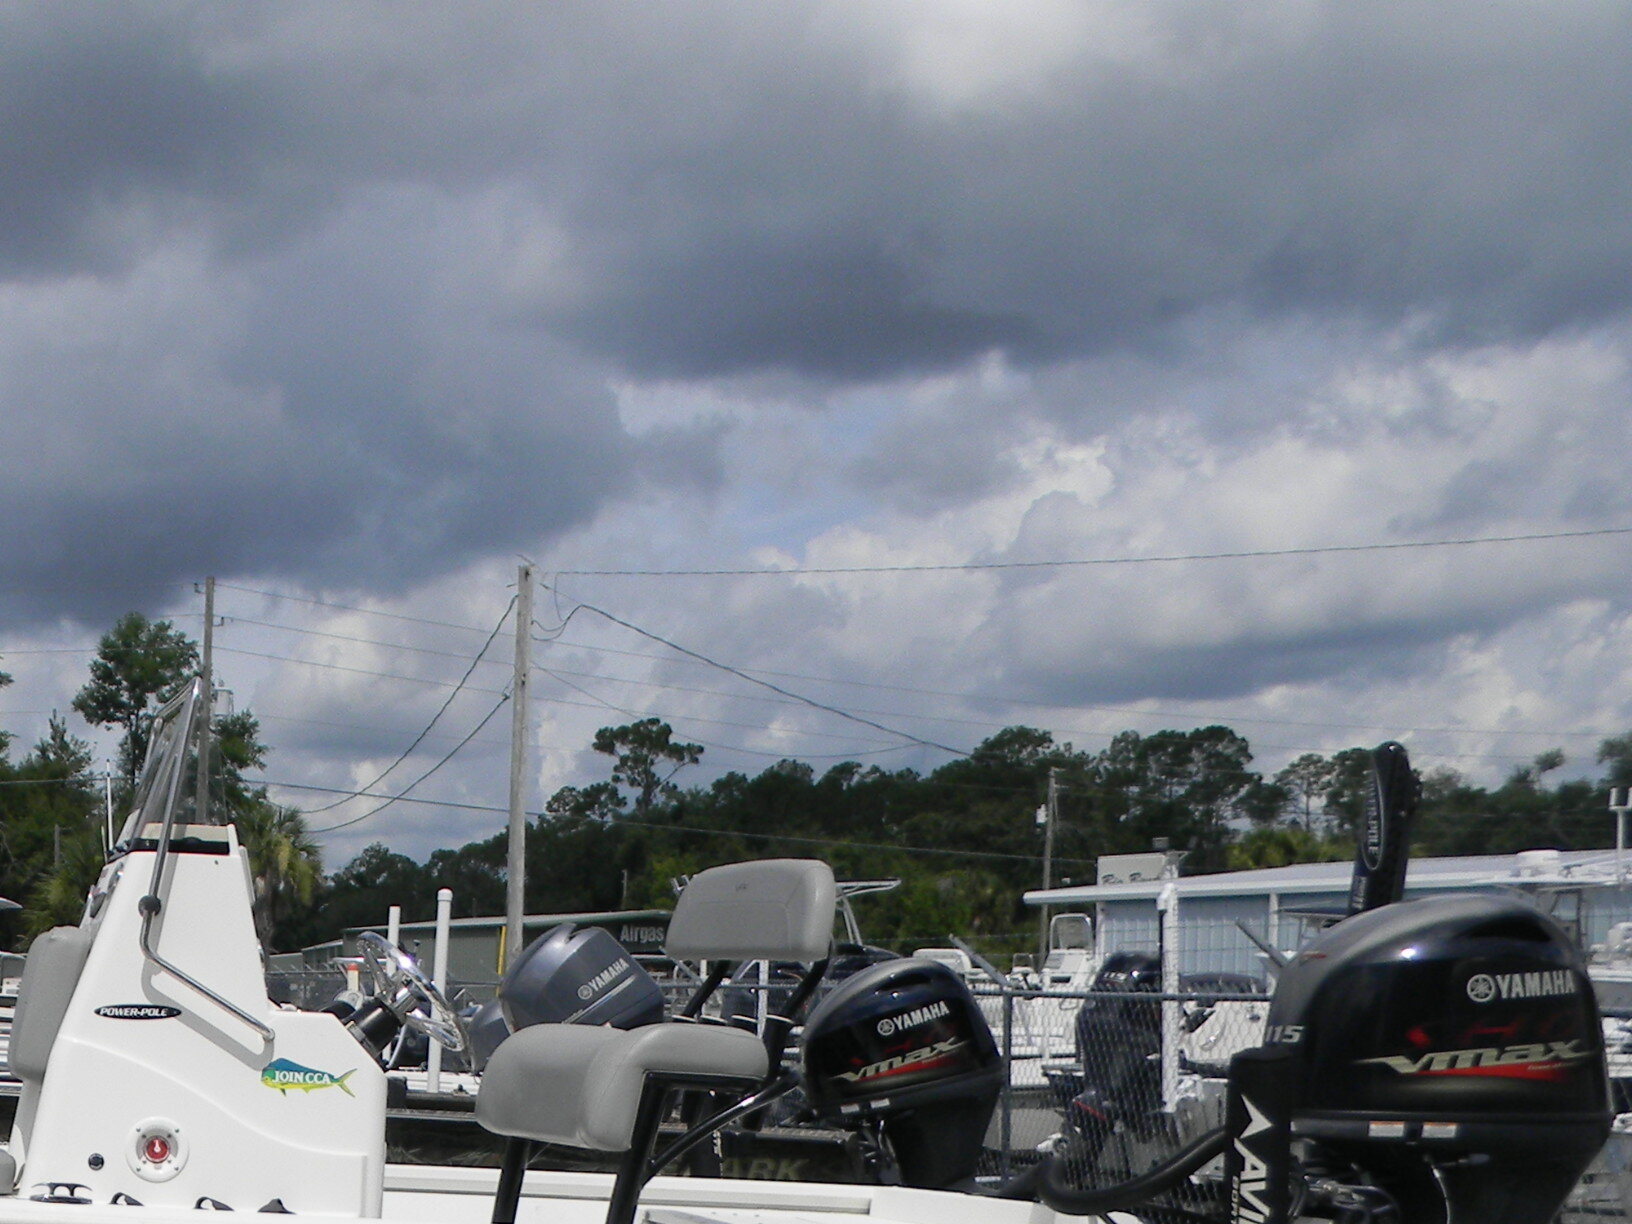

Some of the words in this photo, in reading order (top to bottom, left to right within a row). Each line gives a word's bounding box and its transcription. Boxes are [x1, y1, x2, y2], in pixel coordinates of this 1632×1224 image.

[621, 924, 665, 943] Airgas
[588, 957, 630, 992] YAMAHA
[1495, 969, 1576, 999] YAMAHA
[99, 1007, 168, 1017] POWER-POLE
[893, 1000, 950, 1031] YAMAHA
[272, 1070, 304, 1083] JOIN
[304, 1073, 332, 1084] CCA
